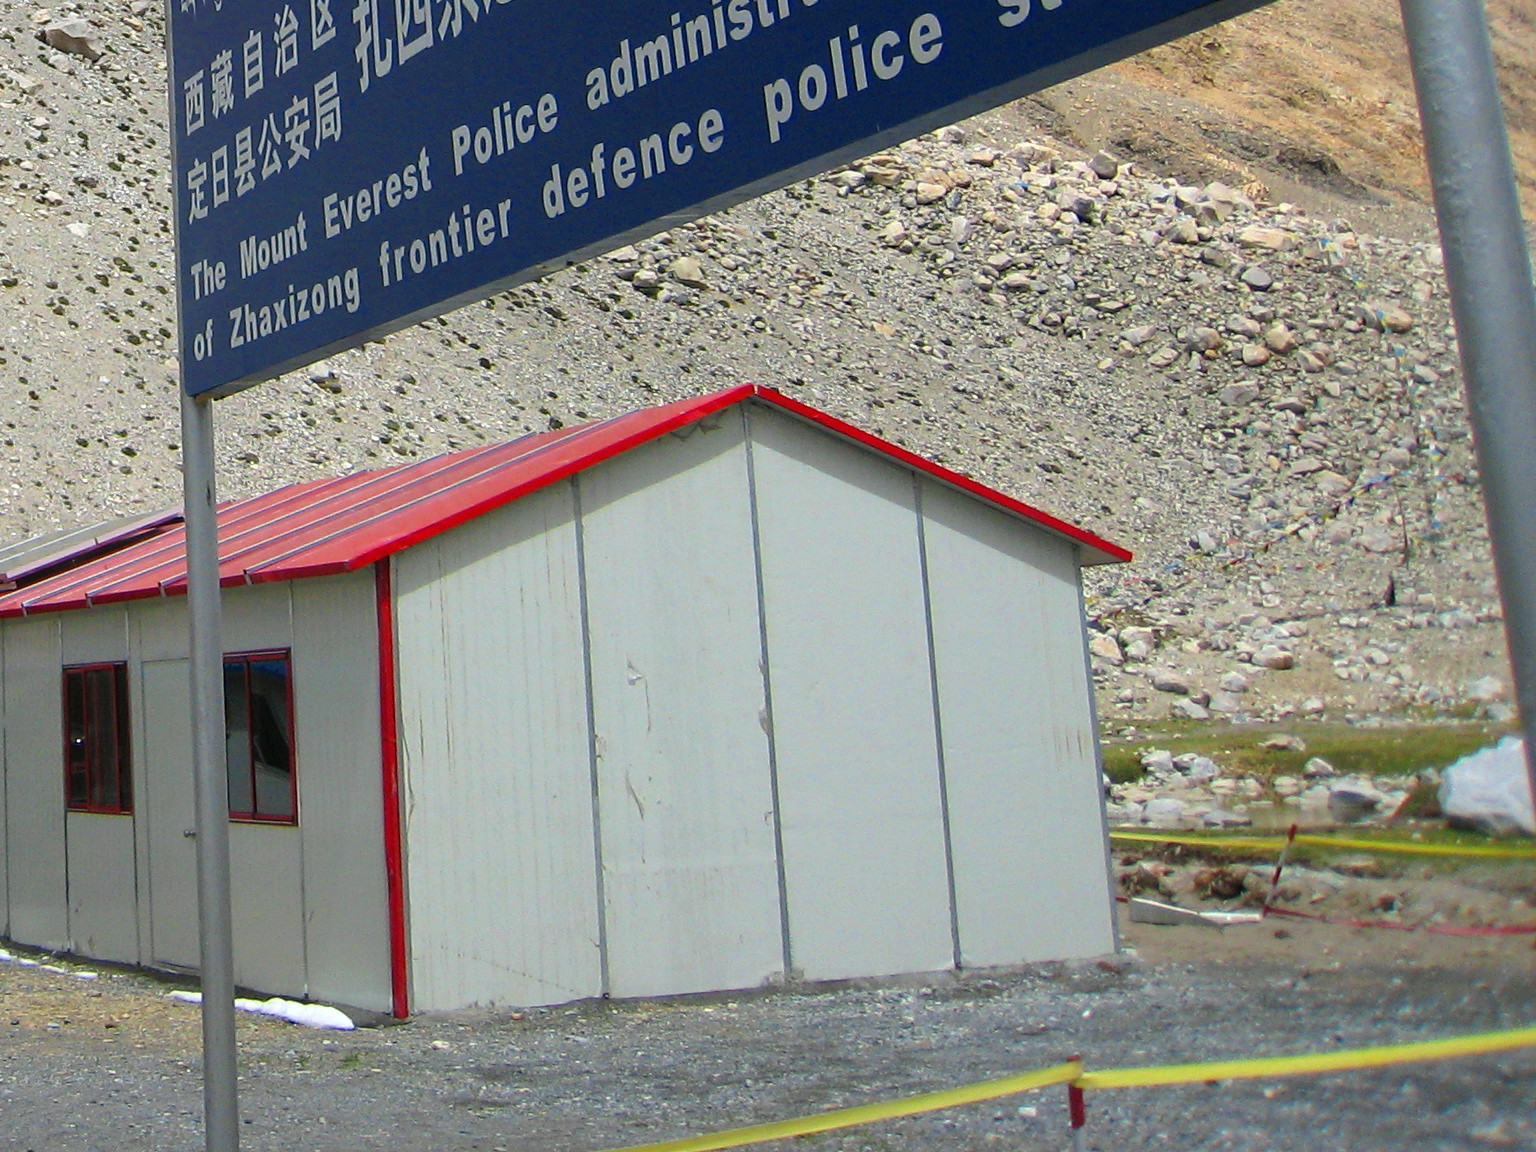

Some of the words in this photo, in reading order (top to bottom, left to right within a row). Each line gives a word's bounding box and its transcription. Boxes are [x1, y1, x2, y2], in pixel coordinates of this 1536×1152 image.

[188, 71, 341, 224] 定日县公安局
[191, 259, 226, 300] The
[240, 212, 307, 279] Mount
[324, 147, 431, 239] Everest
[452, 94, 557, 175] Police
[194, 319, 213, 361] of
[230, 268, 359, 348] Zhaxizong
[380, 199, 510, 286] frontier
[543, 109, 723, 218] defence
[764, 13, 942, 143] police
